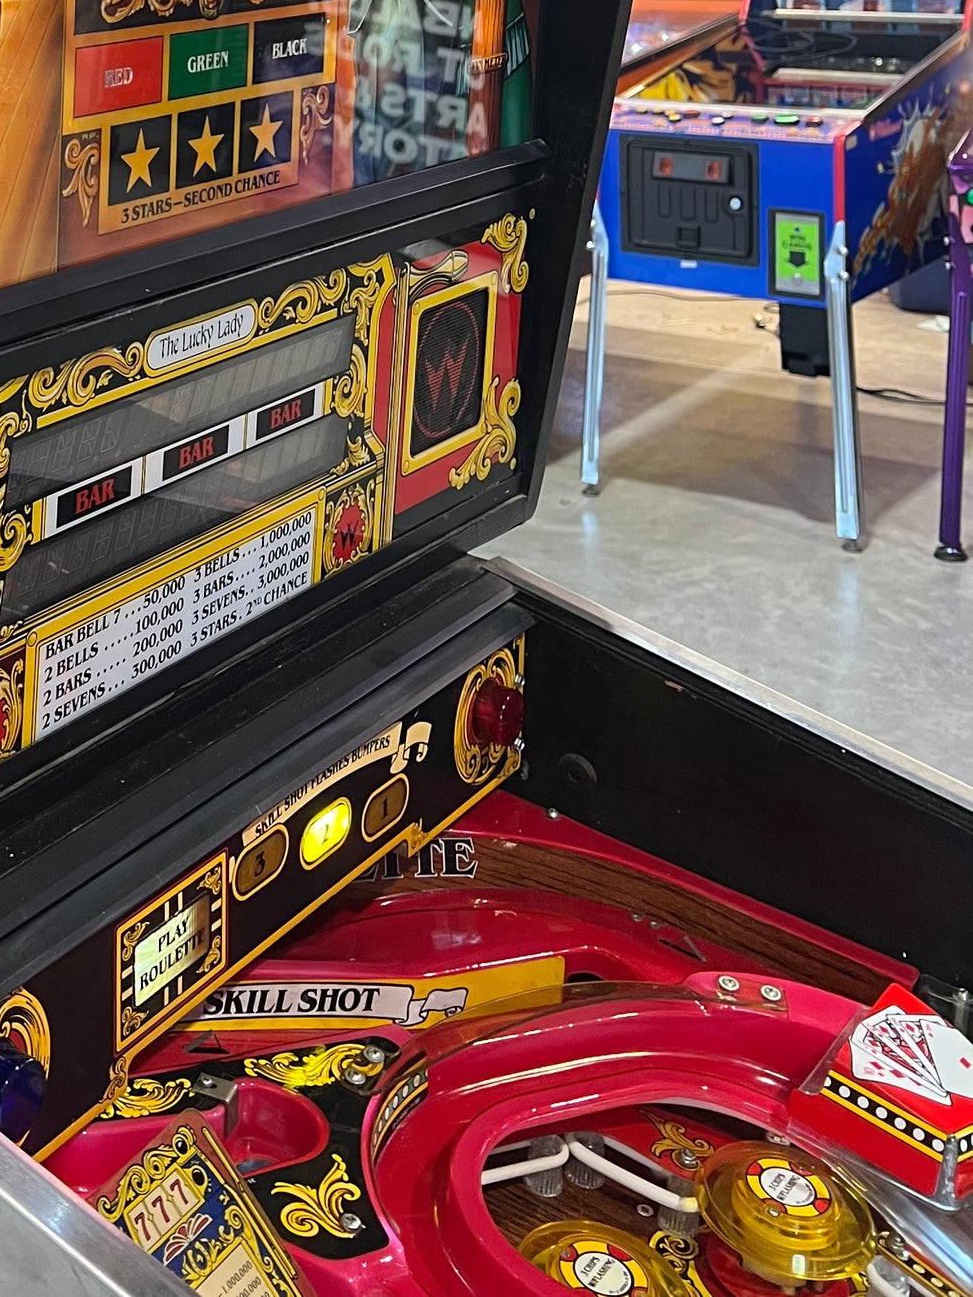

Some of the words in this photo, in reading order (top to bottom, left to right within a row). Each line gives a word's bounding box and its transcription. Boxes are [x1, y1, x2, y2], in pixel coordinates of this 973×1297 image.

[104, 67, 133, 88] RED
[187, 51, 229, 74] GREEN
[271, 38, 308, 60] BLACK
[121, 208, 130, 223] 3
[131, 198, 172, 221] STARS
[183, 181, 233, 208] SECOND
[235, 170, 280, 195] CHANCE
[159, 335, 179, 358] The
[182, 324, 214, 352] Lucky
[217, 312, 244, 338] Lady
[75, 478, 115, 515] BAR
[179, 436, 215, 469] BAR
[270, 399, 302, 429] BAR
[193, 590, 200, 603] 3
[203, 571, 234, 598] BARS
[259, 532, 311, 569] 2,000,000
[194, 569, 201, 582] 3
[204, 548, 240, 577] BELLS
[260, 512, 312, 549] 1,000,000
[45, 632, 73, 660] BAR
[77, 615, 110, 644] BELL
[114, 608, 122, 624] 7
[142, 575, 185, 609] 50,000
[190, 633, 198, 647] 3
[200, 610, 237, 641] STARS
[263, 571, 308, 605] CHANCE
[192, 611, 199, 625] 3
[201, 585, 245, 620] SEVENS
[257, 551, 309, 589] 3,000,000
[43, 690, 52, 707] 2
[55, 668, 92, 700] BARS
[133, 619, 183, 657] 200,000
[44, 666, 53, 684] 2
[56, 641, 99, 677] BELLS
[135, 598, 184, 635] 100,000
[42, 713, 51, 730] 2
[54, 682, 106, 723] SEVENS
[131, 640, 182, 679] 300,000
[255, 808, 283, 838] SKILL
[284, 784, 310, 810] SHOT
[351, 735, 391, 764] BUMPERS
[253, 850, 267, 876] 3
[321, 824, 330, 846] 2
[380, 798, 389, 820] 1
[140, 928, 205, 992] ROULETTE
[158, 916, 189, 953] PLAY
[203, 989, 293, 1015] SKILL
[297, 988, 380, 1013] SHOT
[134, 1211, 151, 1242] 7
[152, 1195, 170, 1224] 7
[169, 1178, 189, 1206] 7
